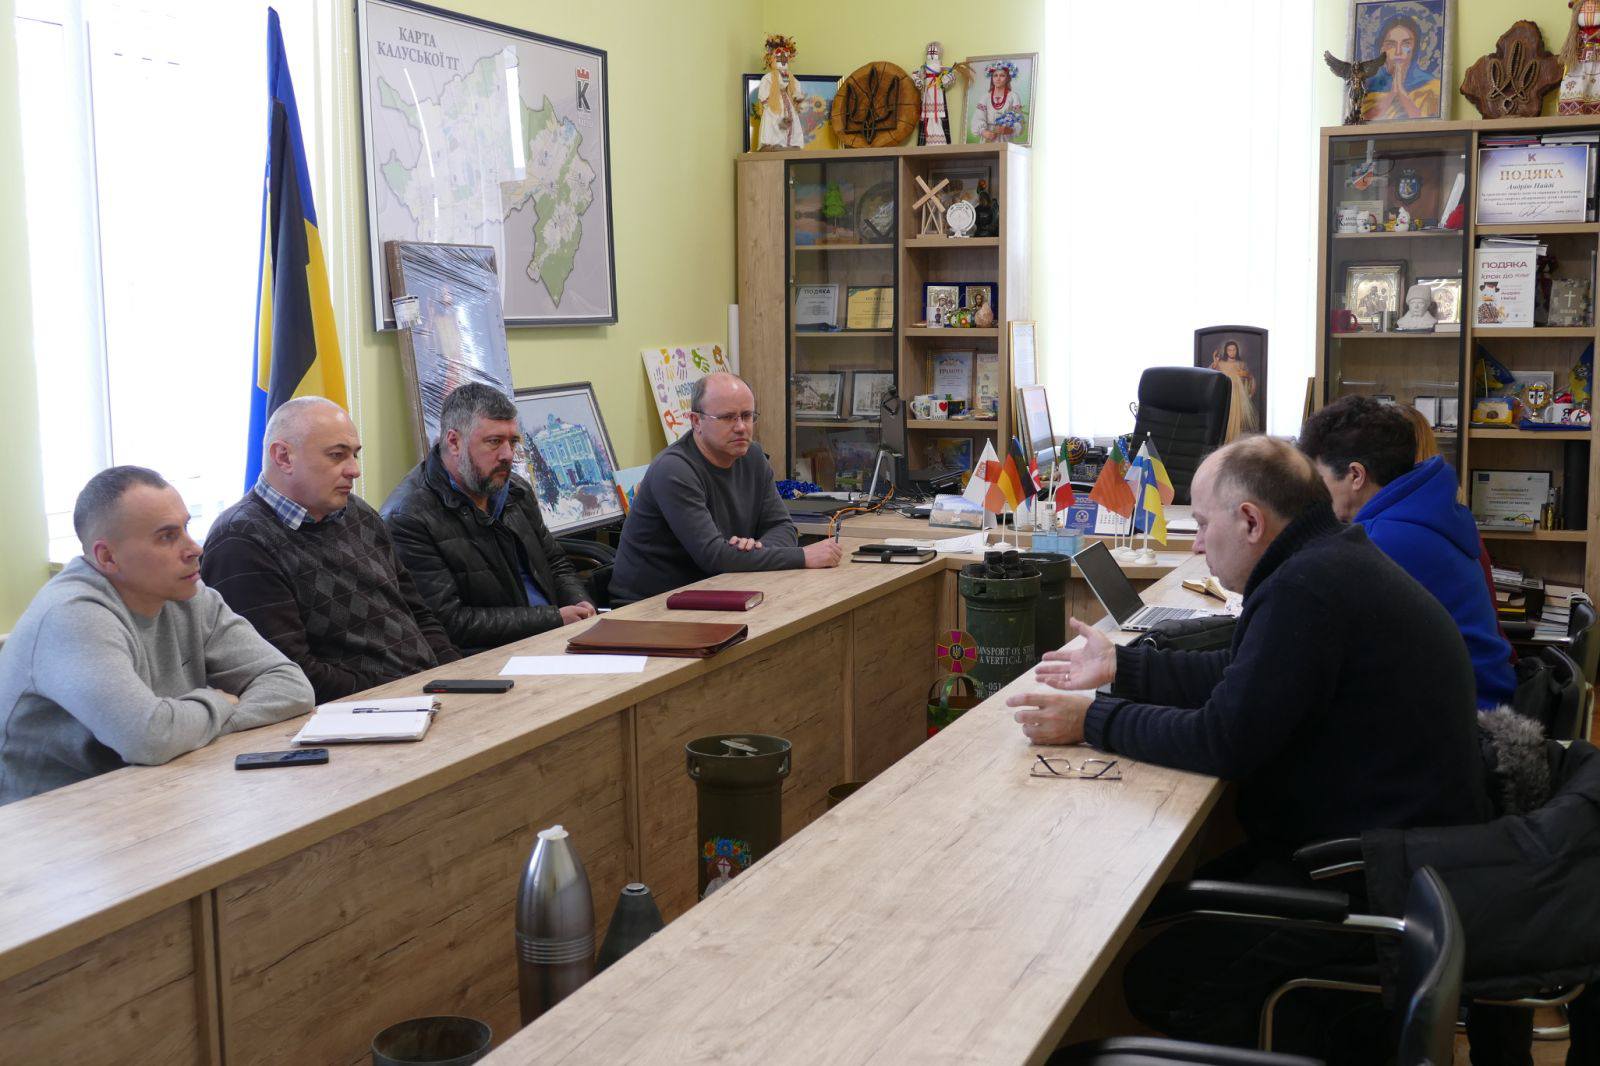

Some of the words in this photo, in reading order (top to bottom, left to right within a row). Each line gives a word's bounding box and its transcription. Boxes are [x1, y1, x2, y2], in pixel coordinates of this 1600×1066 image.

[398, 27, 436, 48] КАРТА
[376, 41, 444, 68] КАЛУСЬКОЇ
[445, 56, 460, 71] ТГ
[1500, 168, 1564, 181] ПОДЯКА
[1482, 261, 1528, 269] ПОДЯКА
